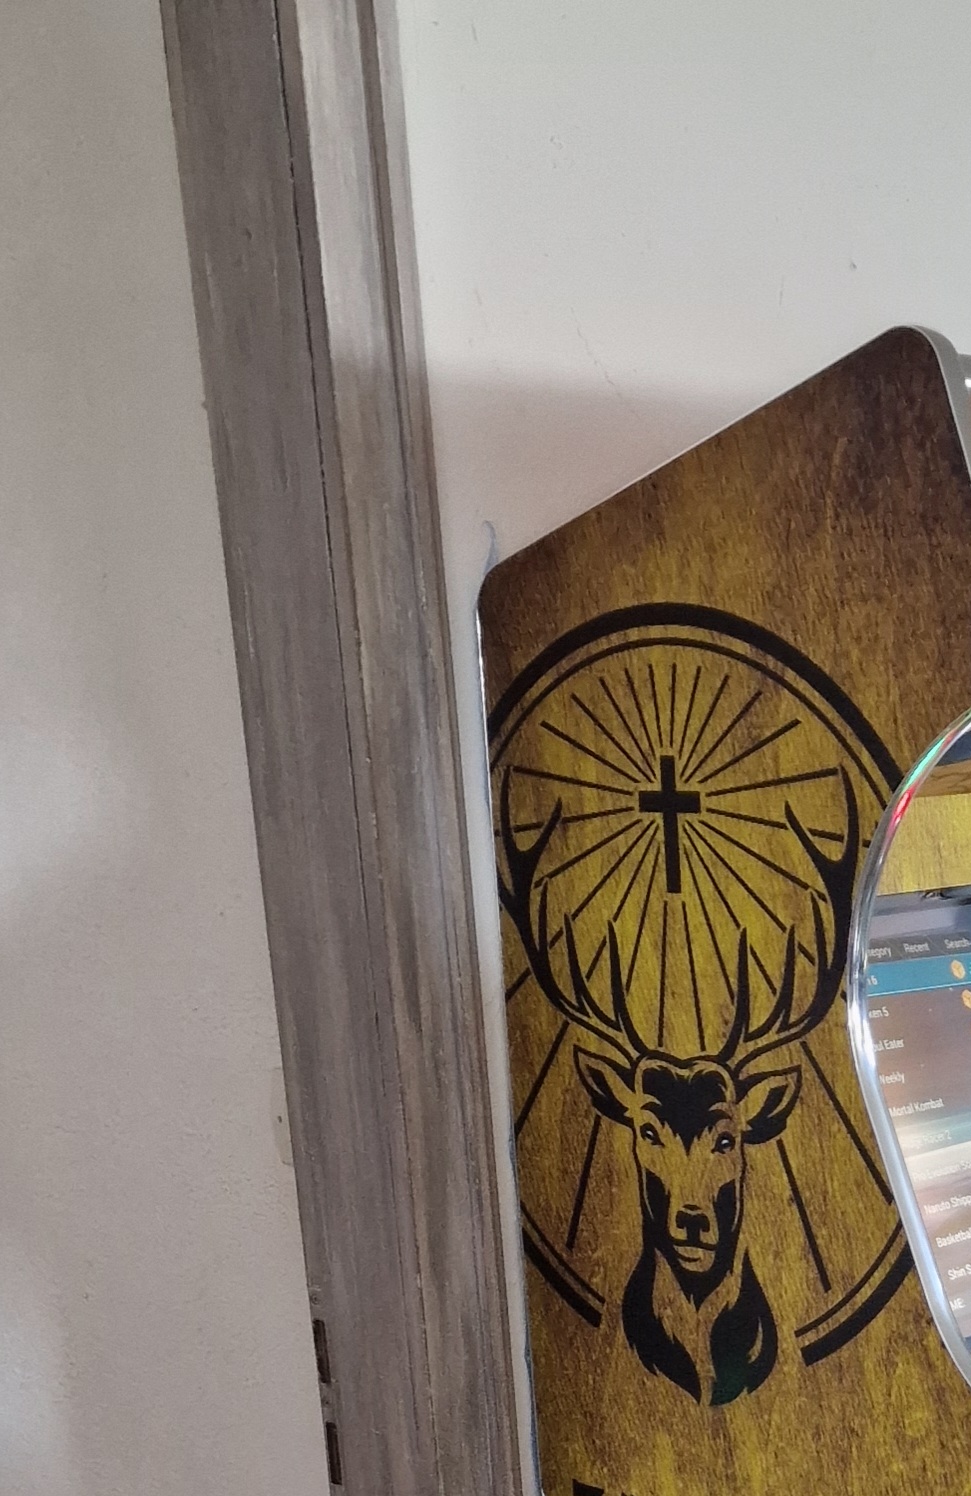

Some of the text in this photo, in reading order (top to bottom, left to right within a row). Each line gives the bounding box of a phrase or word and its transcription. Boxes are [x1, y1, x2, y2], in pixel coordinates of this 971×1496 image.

[904, 942, 930, 954] Recent
[884, 1038, 904, 1050] Eater
[889, 1098, 944, 1117] Mortal Kombat
[948, 1268, 966, 1280] Shin
